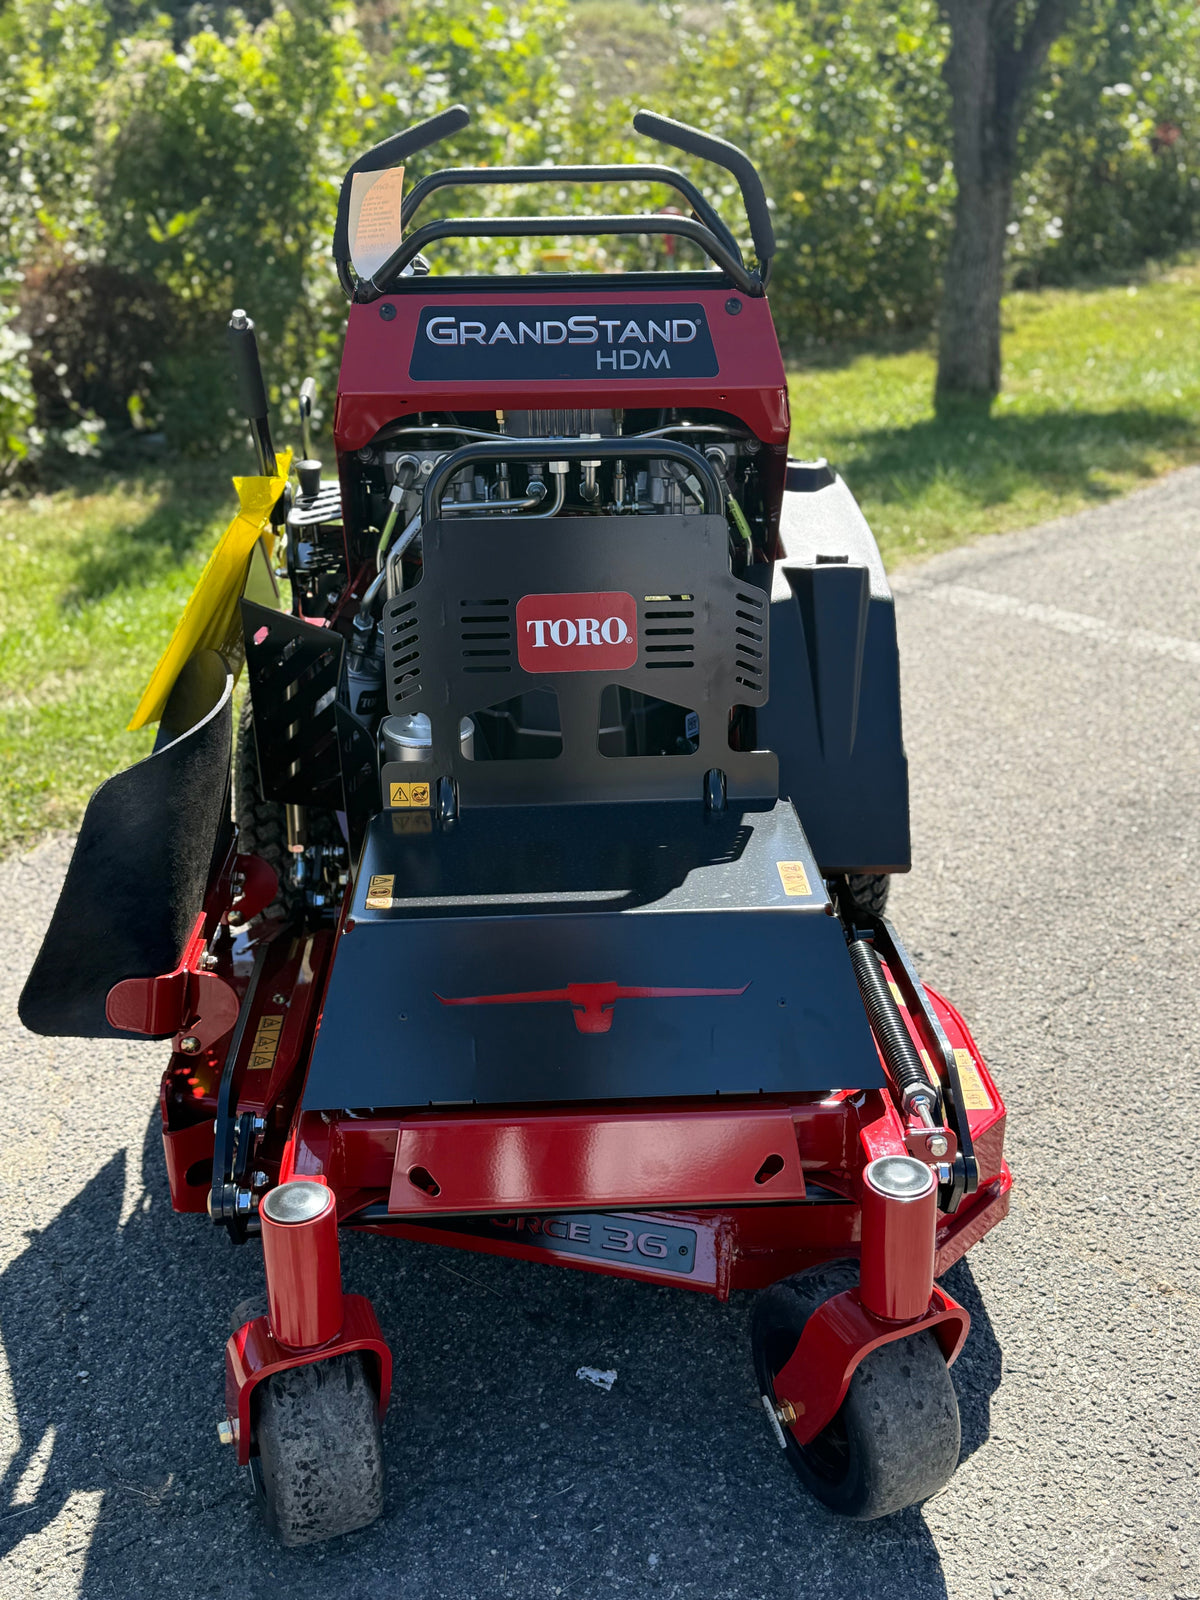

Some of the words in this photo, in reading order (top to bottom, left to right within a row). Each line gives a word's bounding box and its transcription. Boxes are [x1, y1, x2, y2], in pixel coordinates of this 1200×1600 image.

[596, 349, 671, 371] HDM
[526, 616, 629, 648] TORO
[601, 1225, 668, 1259] 36
